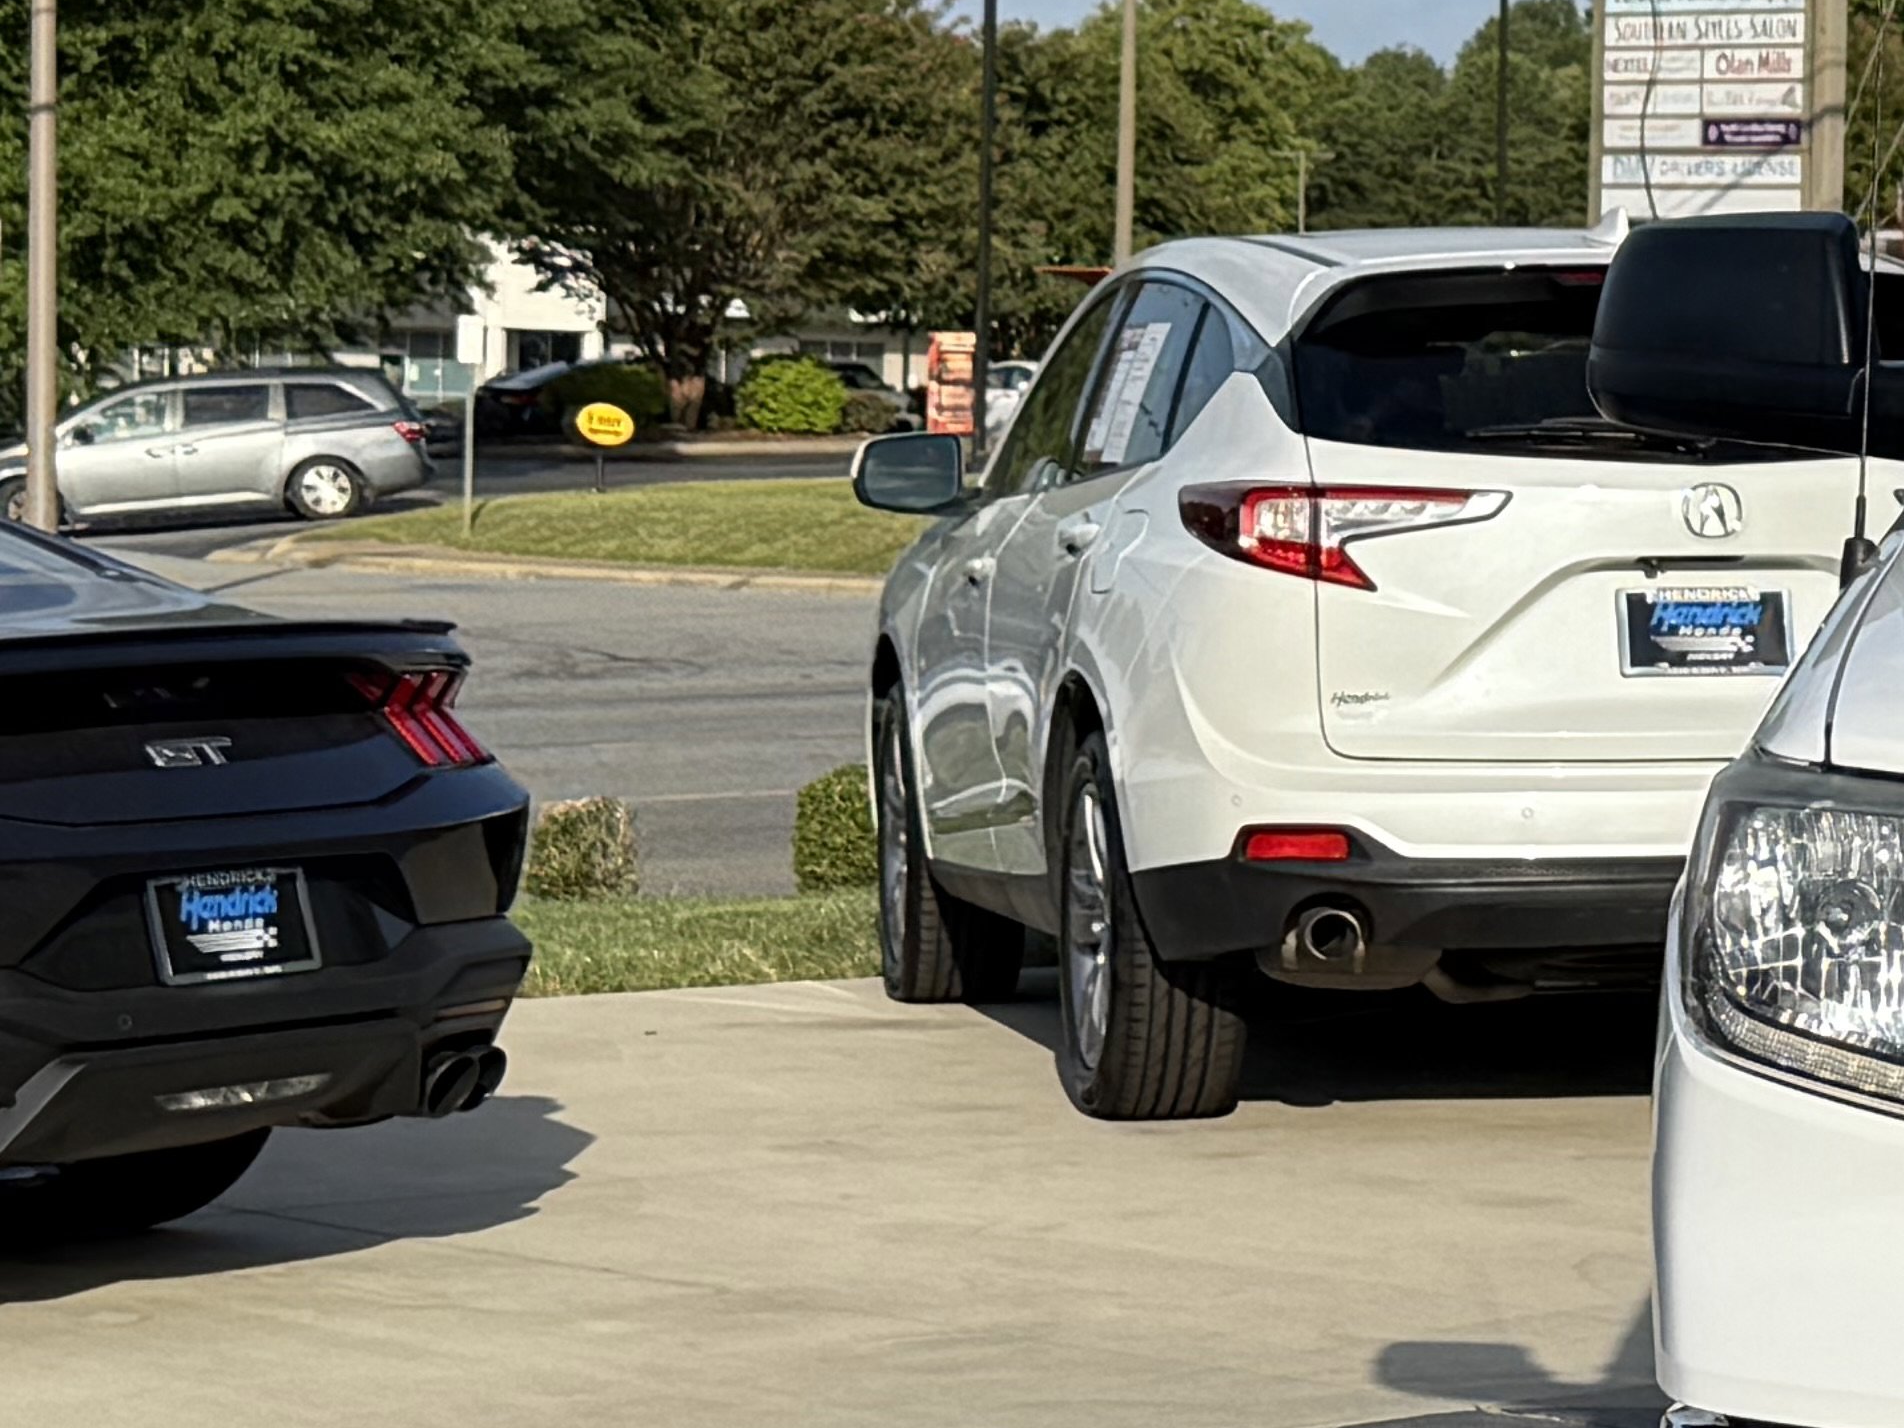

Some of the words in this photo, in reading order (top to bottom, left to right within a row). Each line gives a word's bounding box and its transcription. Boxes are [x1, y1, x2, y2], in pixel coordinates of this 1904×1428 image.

[1750, 16, 1798, 40] SALON
[1715, 51, 1755, 75] Olan
[179, 884, 279, 931] Hendrick
